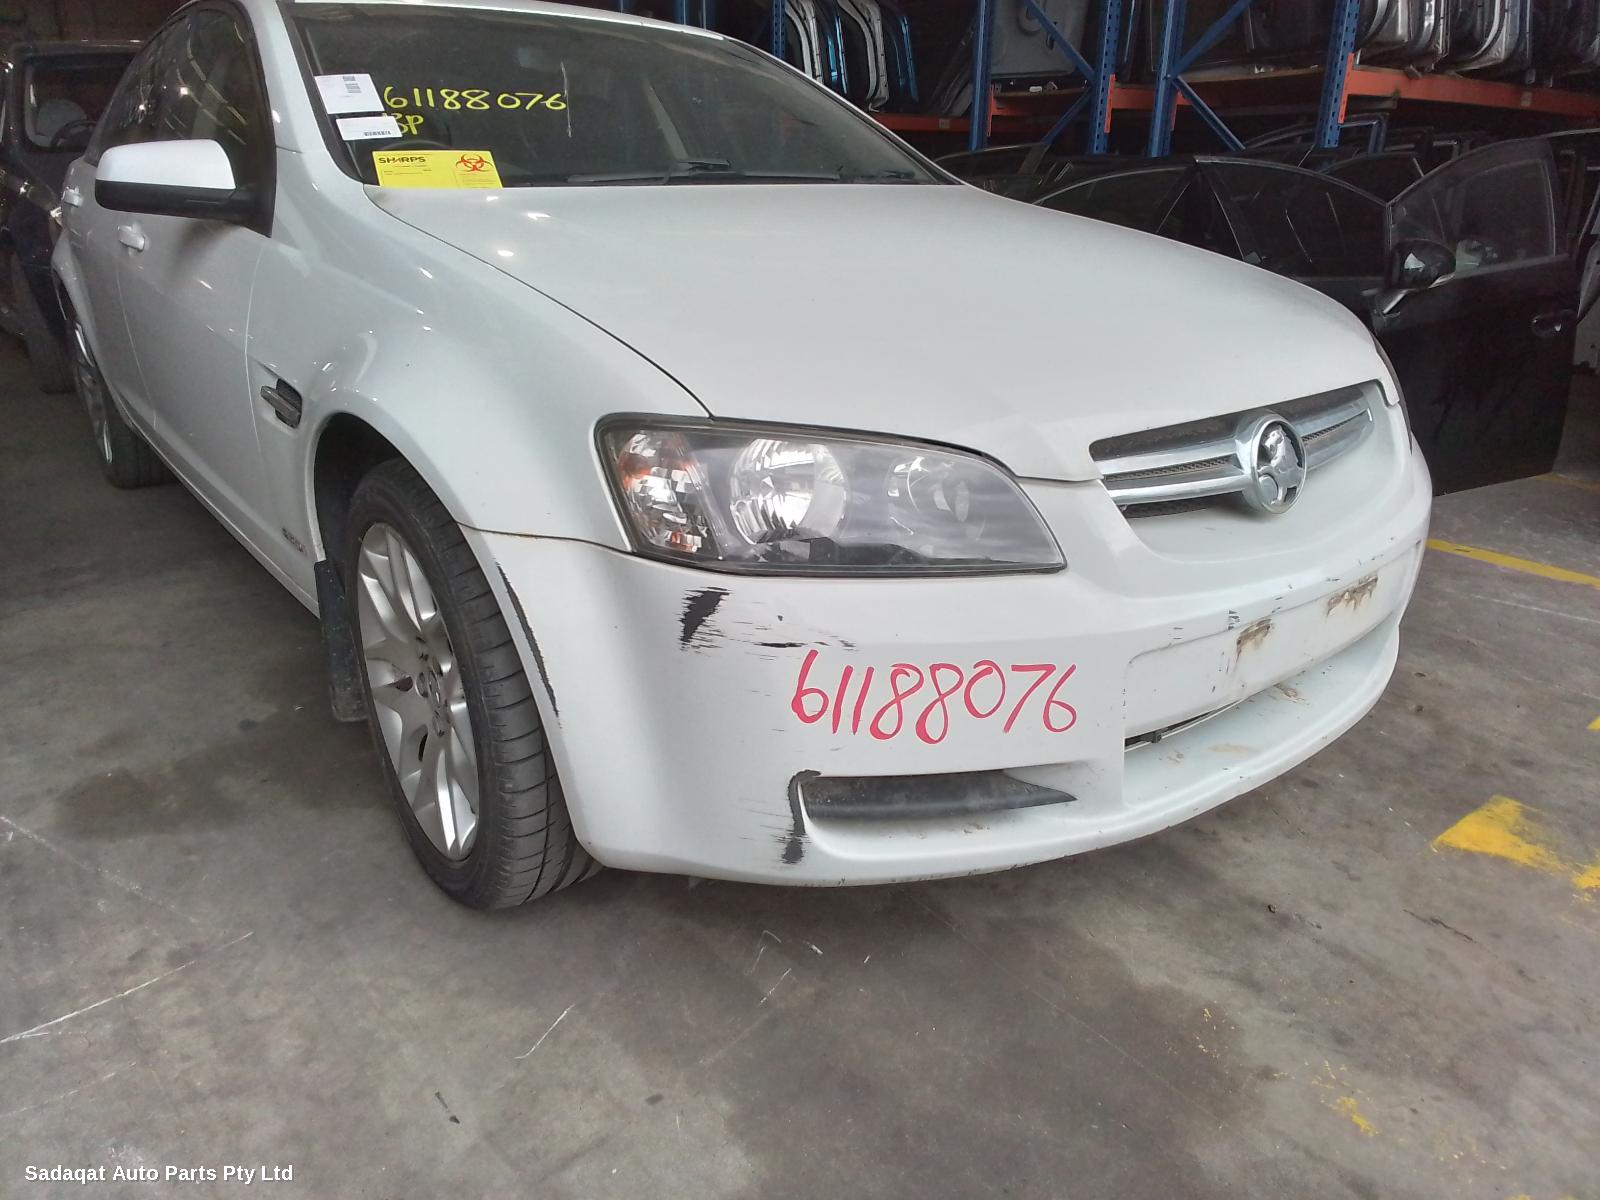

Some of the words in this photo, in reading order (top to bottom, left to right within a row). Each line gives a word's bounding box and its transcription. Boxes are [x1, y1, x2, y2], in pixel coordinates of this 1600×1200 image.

[383, 86, 567, 111] 61188076
[378, 156, 426, 164] SHARPS
[791, 649, 1077, 744] 61188076
